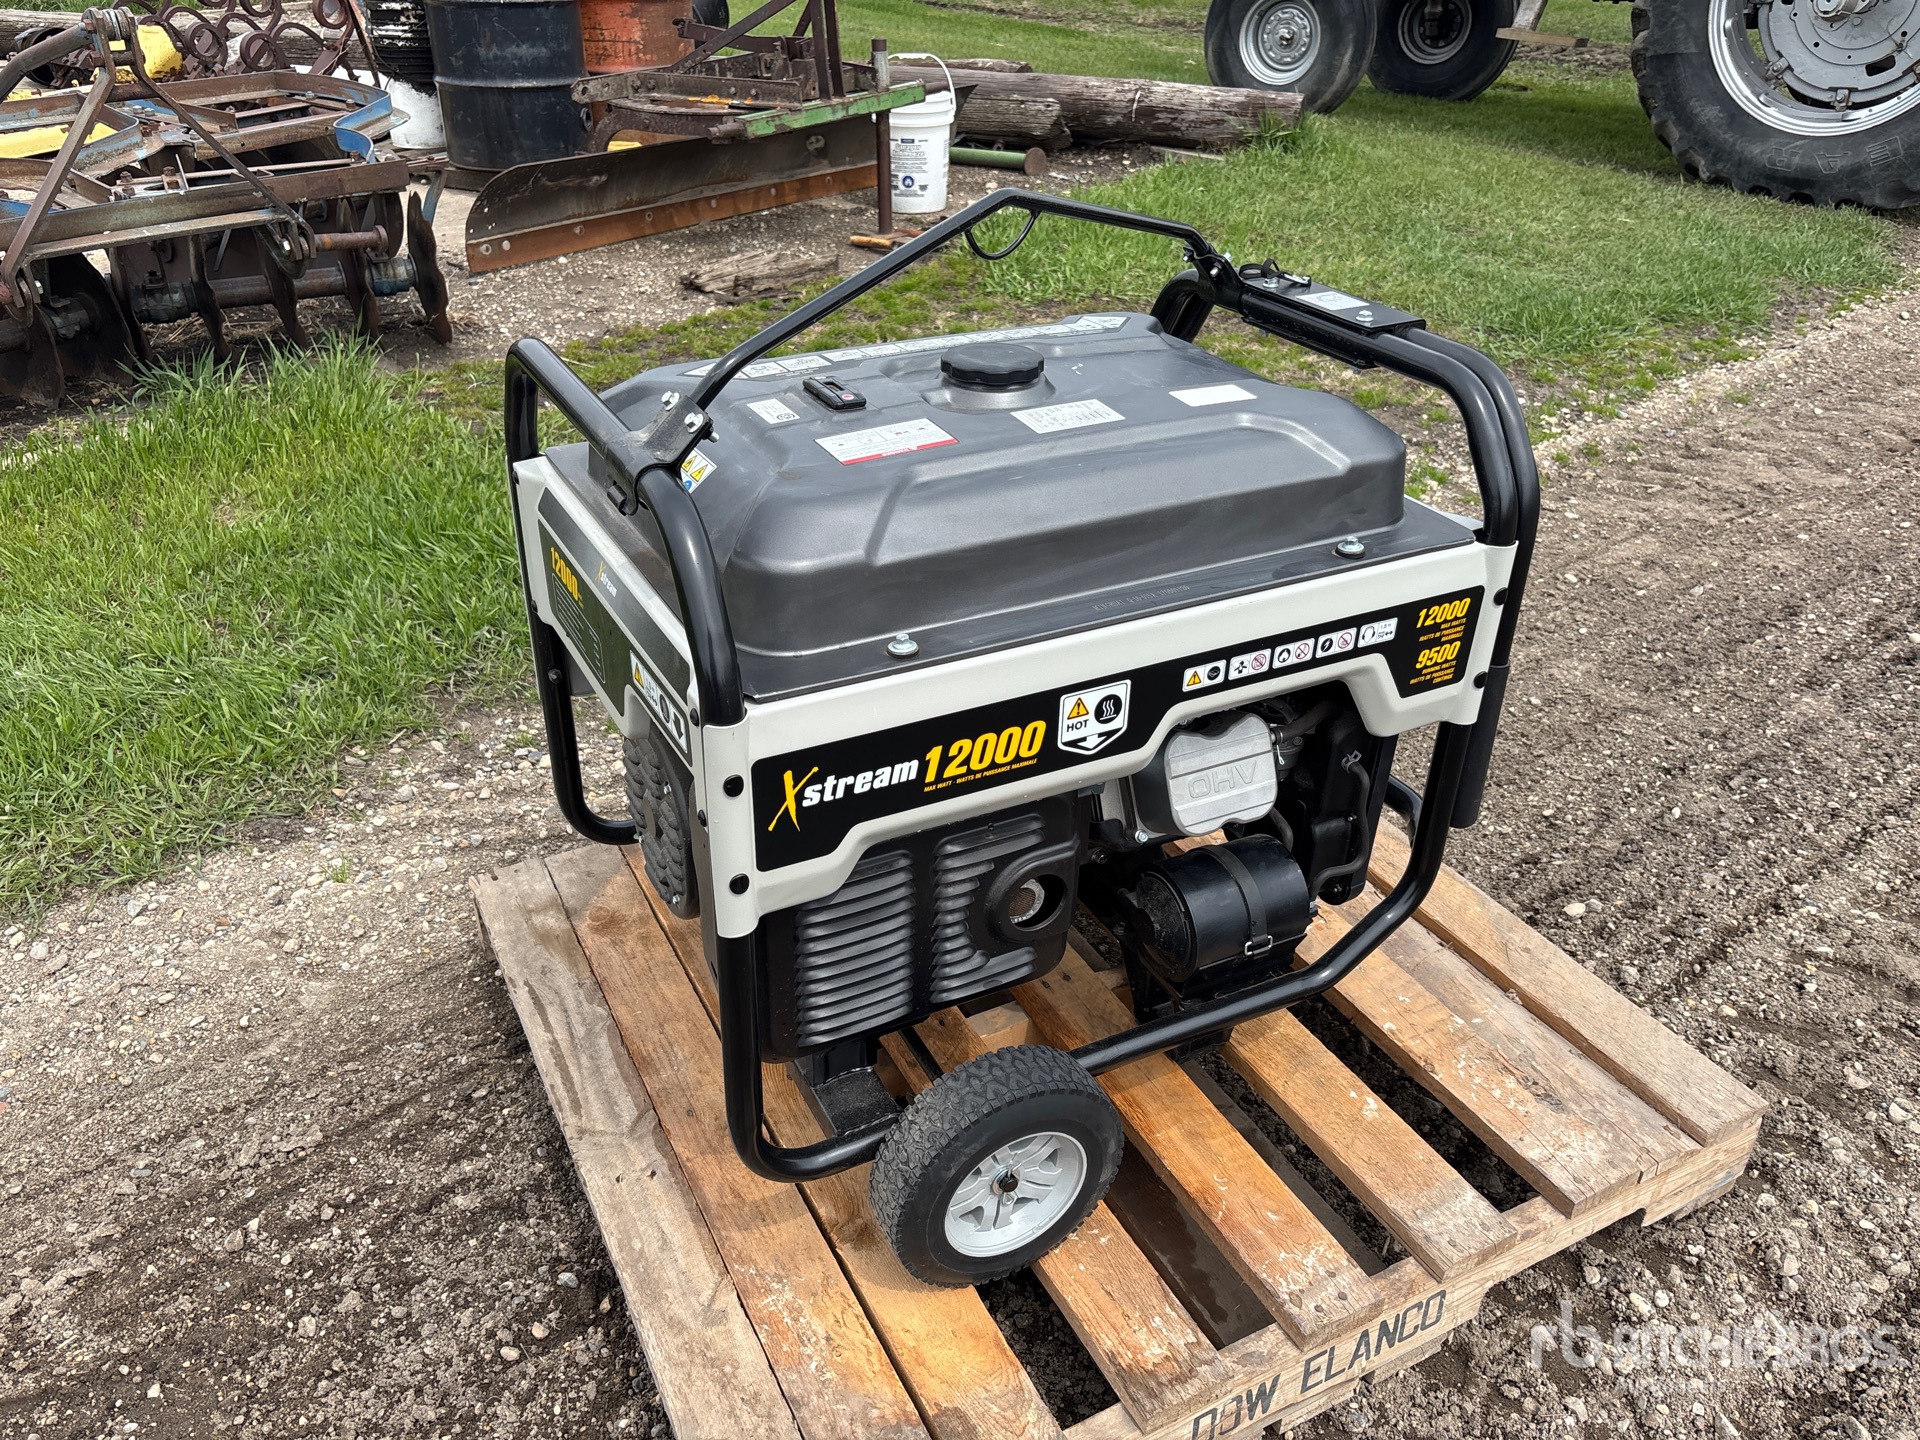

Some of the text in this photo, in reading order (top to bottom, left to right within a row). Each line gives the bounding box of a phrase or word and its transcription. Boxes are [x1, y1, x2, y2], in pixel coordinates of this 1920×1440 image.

[551, 547, 579, 601] 12000
[1416, 597, 1471, 628] 12000
[1415, 641, 1461, 669] 9500
[1066, 719, 1090, 732] HOT
[768, 720, 1047, 832] Xstream 12000
[924, 783, 937, 792] MAX
[937, 780, 953, 789] WATT
[956, 775, 974, 784] WATTS
[982, 765, 1012, 777] PUISSANCE
[1011, 758, 1038, 770] MAXIMALE
[1188, 760, 1257, 799] OHV
[1300, 1290, 1446, 1374] ELANCO
